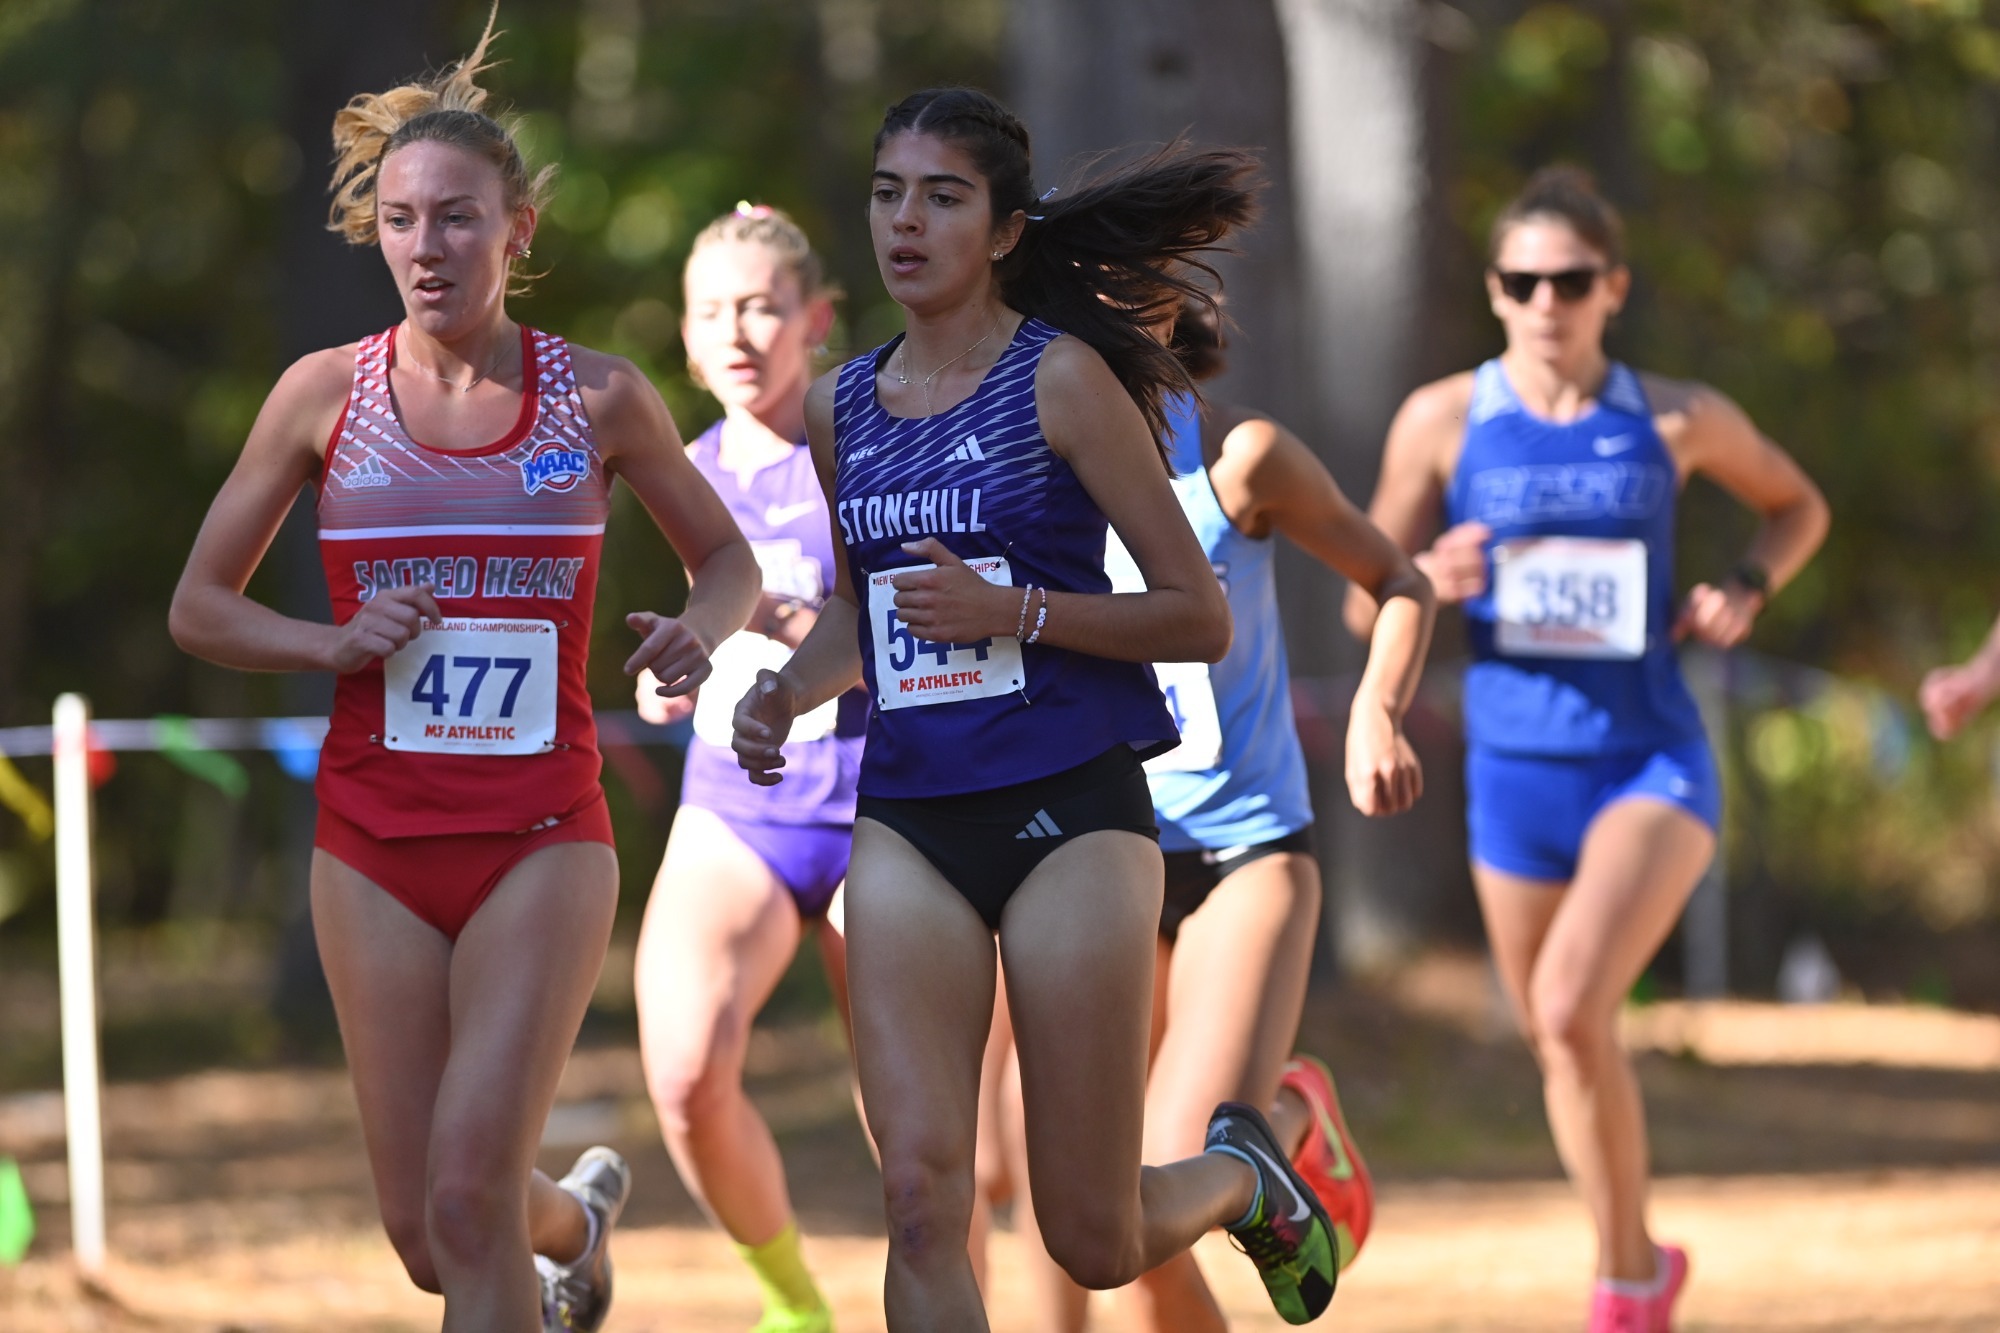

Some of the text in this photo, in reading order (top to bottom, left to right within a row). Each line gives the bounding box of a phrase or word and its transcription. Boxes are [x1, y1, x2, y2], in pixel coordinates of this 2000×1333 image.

[847, 445, 879, 464] NEC
[343, 472, 391, 488] adidas
[523, 450, 588, 490] MAAC
[838, 488, 987, 546] STONEHILL
[354, 556, 586, 602] SACRED HEART
[875, 574, 888, 586] NEW
[1523, 569, 1618, 626] 358
[423, 620, 546, 633] ENGLAND CHAMPIONSHIPS
[412, 654, 532, 718] 477
[918, 670, 983, 691] ATHLETIC
[447, 726, 515, 740] ATHLETIC
